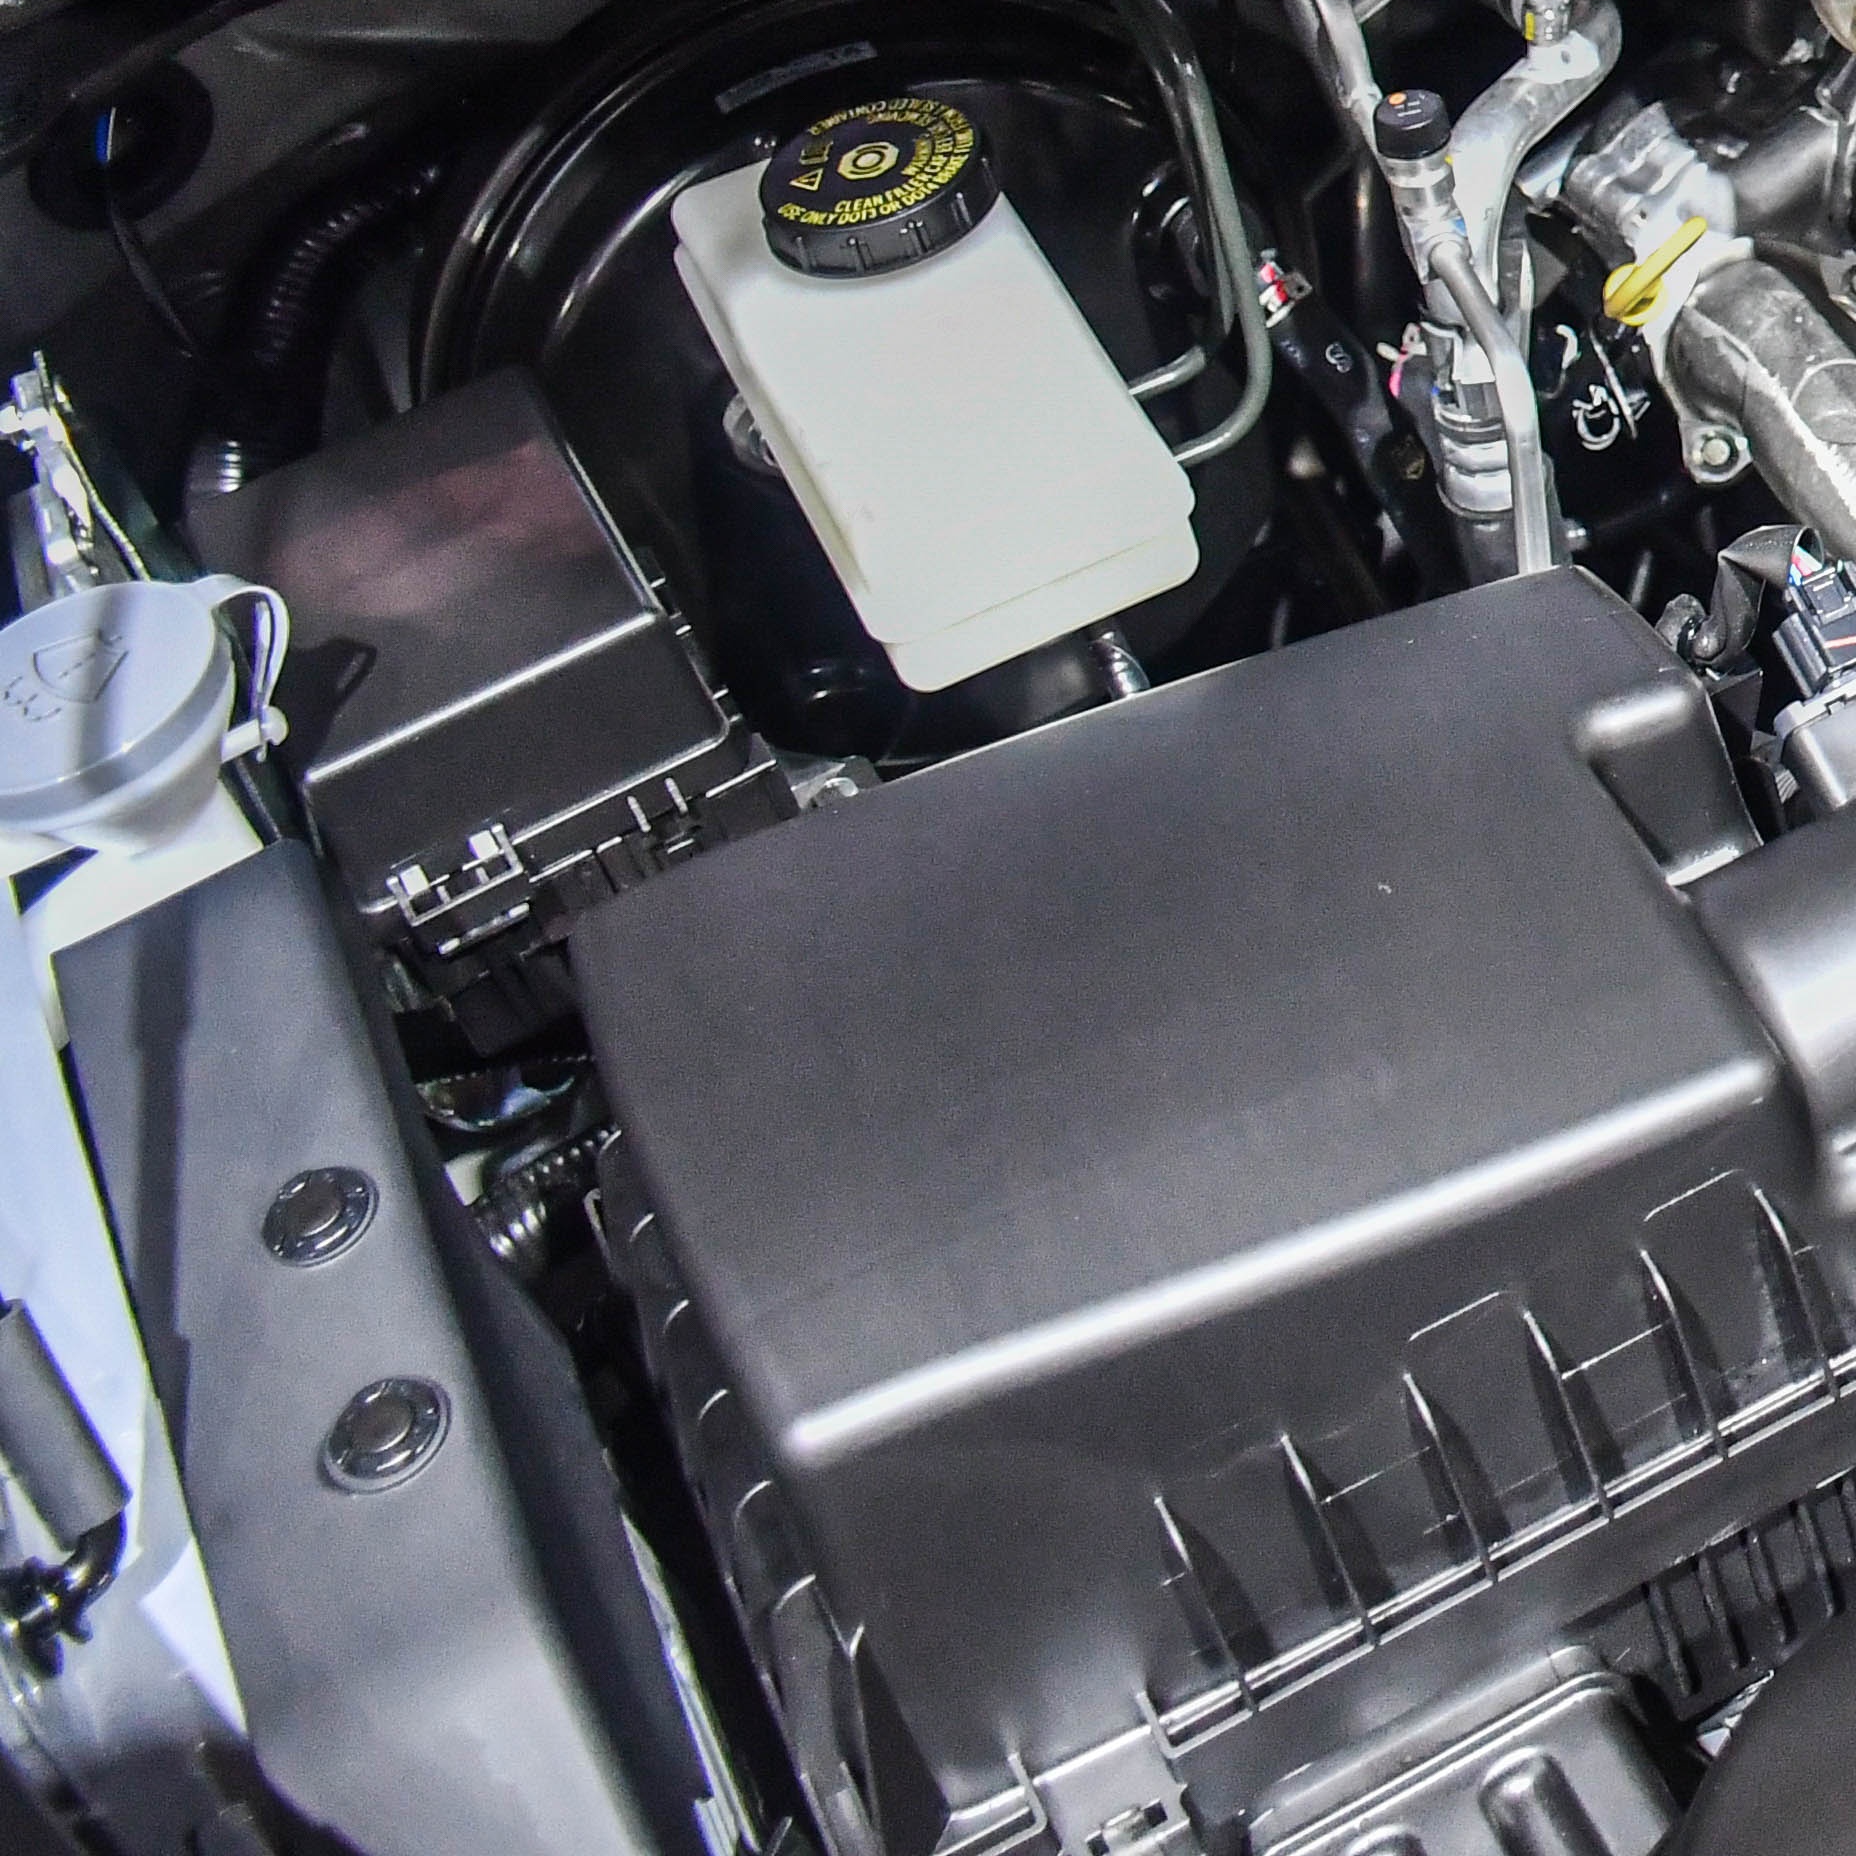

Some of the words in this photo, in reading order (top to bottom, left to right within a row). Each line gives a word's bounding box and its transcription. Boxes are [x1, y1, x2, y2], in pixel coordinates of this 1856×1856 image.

[801, 208, 838, 226] ONLY
[837, 207, 877, 226] DOT3
[880, 199, 902, 215] OR
[900, 182, 940, 208] DOT4
[835, 193, 883, 214] CLEAN
[885, 174, 930, 204] FILLER
[924, 152, 946, 176] CAP
